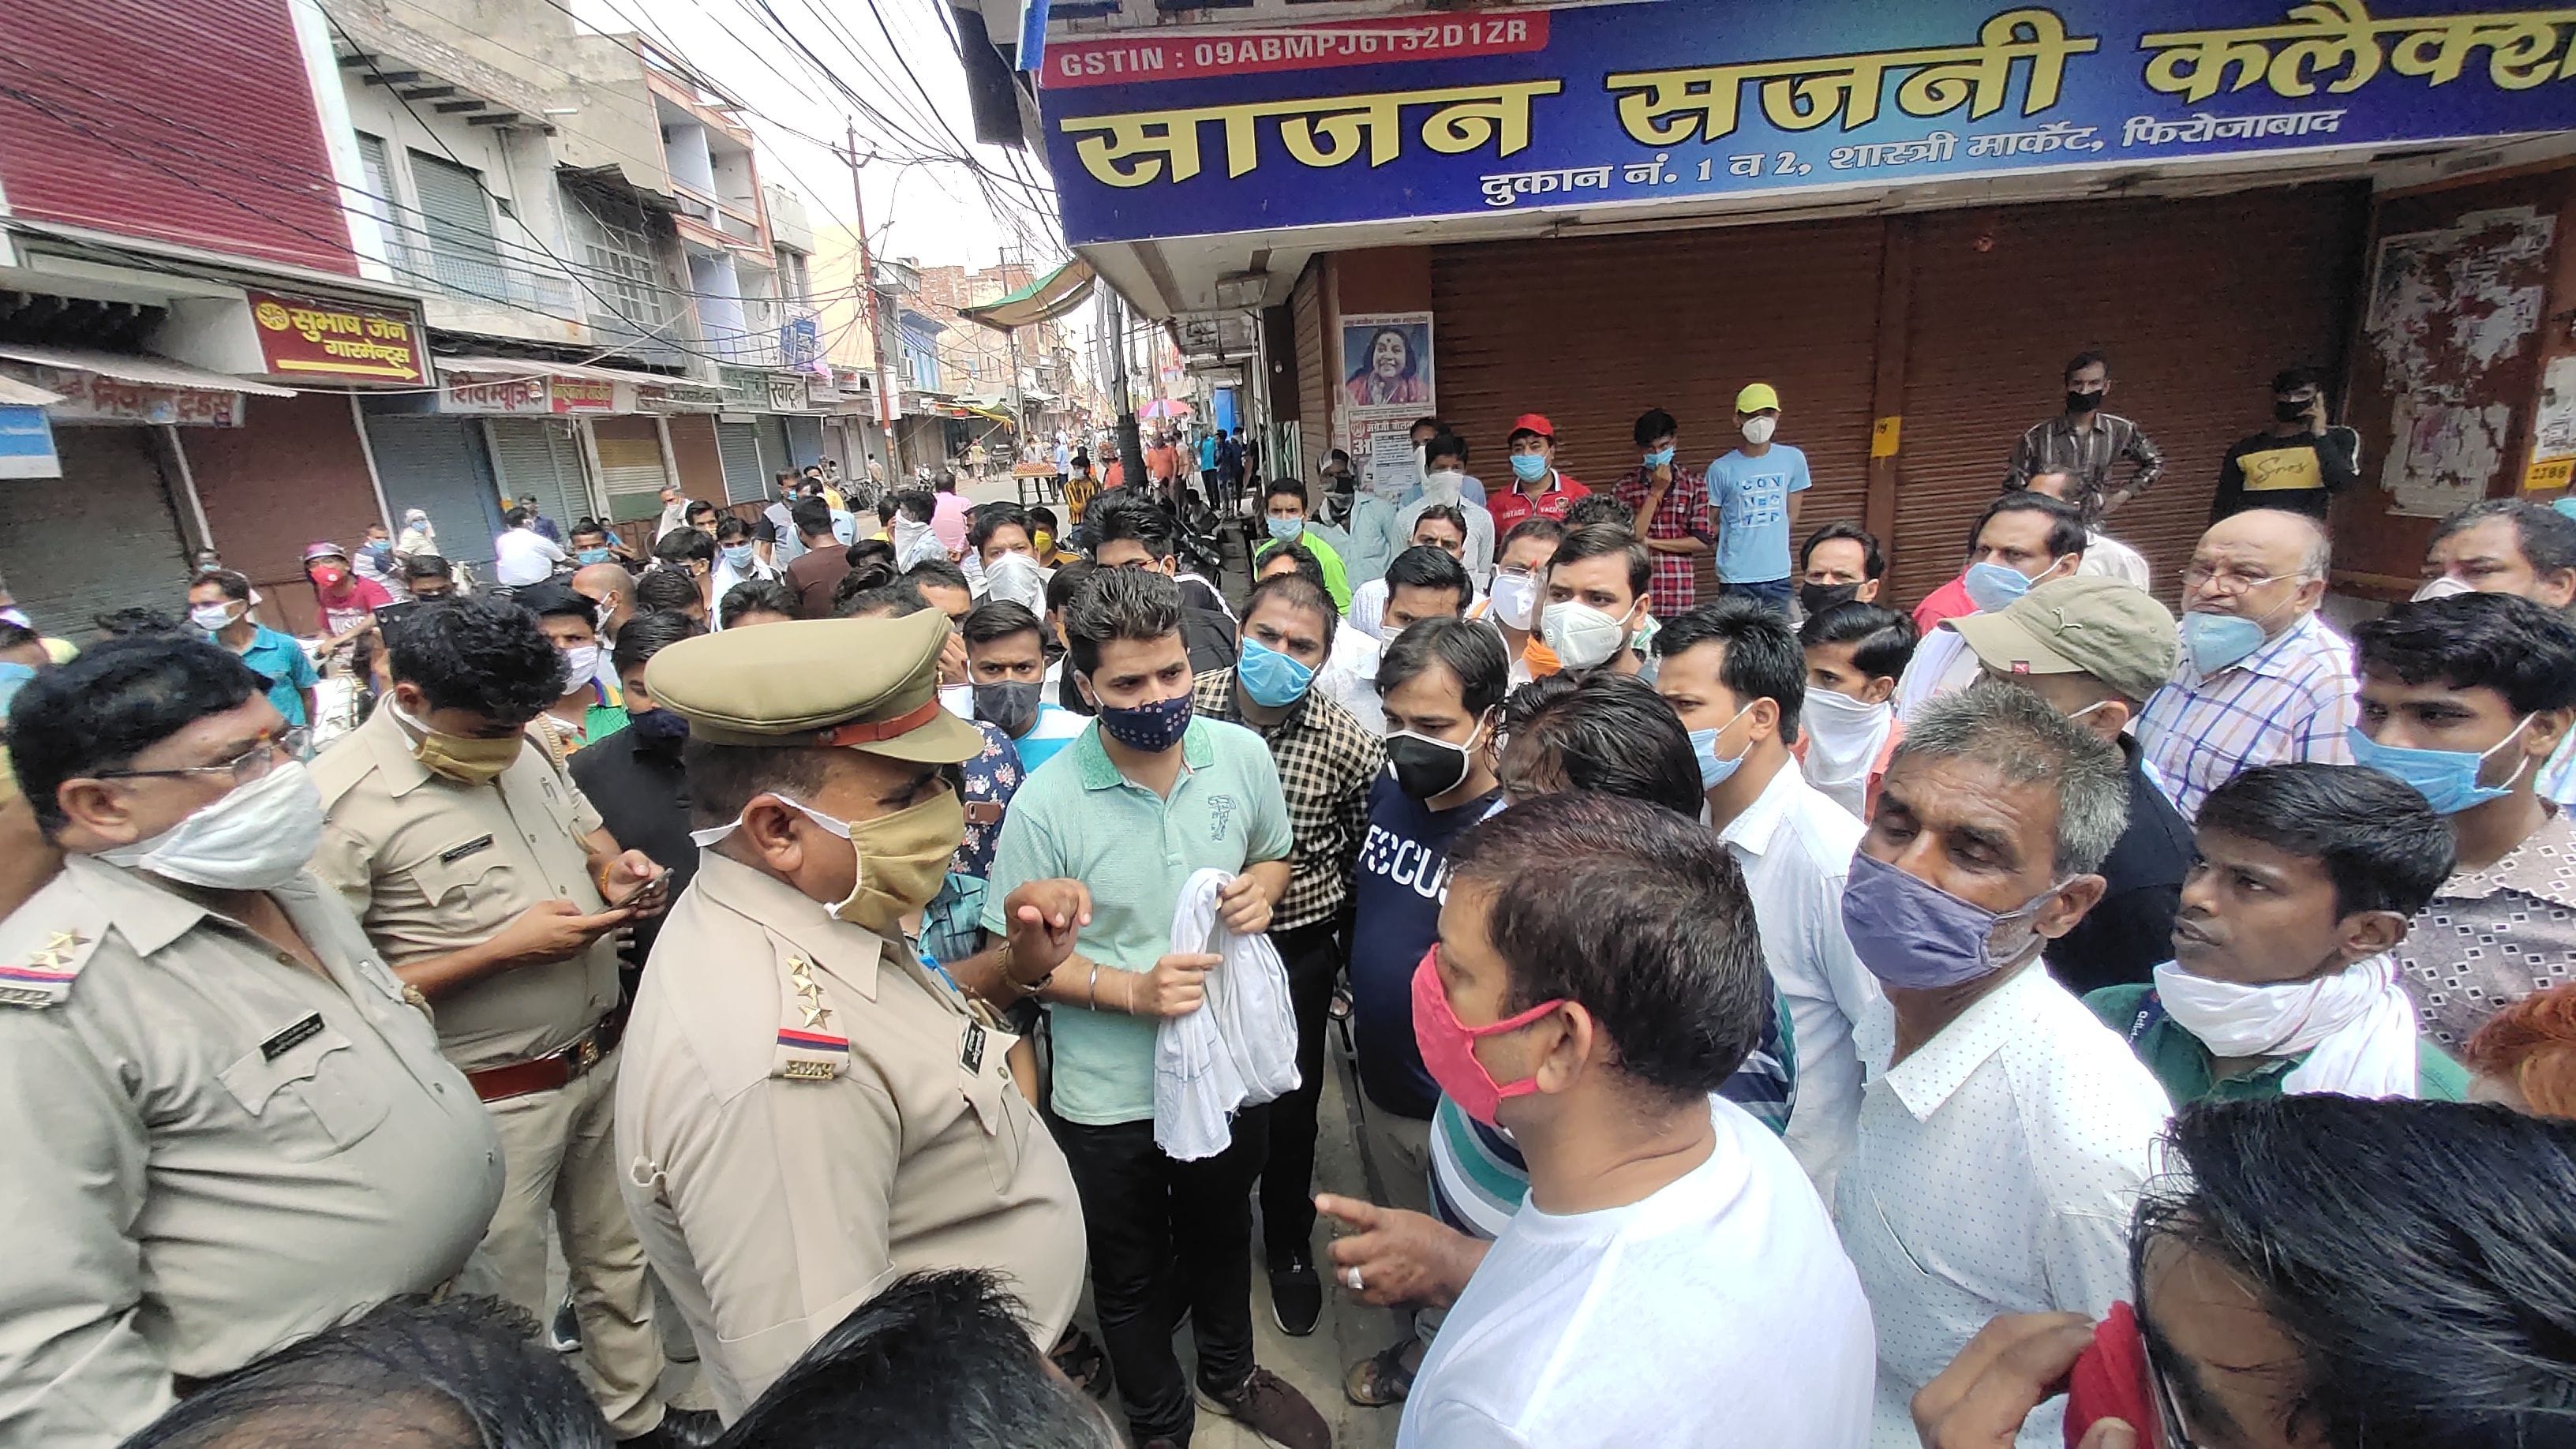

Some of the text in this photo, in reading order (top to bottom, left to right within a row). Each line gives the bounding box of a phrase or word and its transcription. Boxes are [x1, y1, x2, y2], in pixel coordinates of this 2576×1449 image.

[1060, 46, 1165, 77] GSTIN
[1060, 80, 1561, 188] साजन
[1606, 8, 2099, 147] सजनी
[1480, 164, 1614, 206] दुकान
[1623, 152, 1679, 185] नं.
[1697, 157, 1713, 182] 1
[1728, 153, 1766, 178] व
[1773, 152, 1813, 177] 2,
[1829, 131, 1958, 170] शास्त्री
[2122, 108, 2347, 148] फिरोजाबाद
[289, 308, 363, 343] सुभाष
[2129, 1010, 2149, 1043] adid
